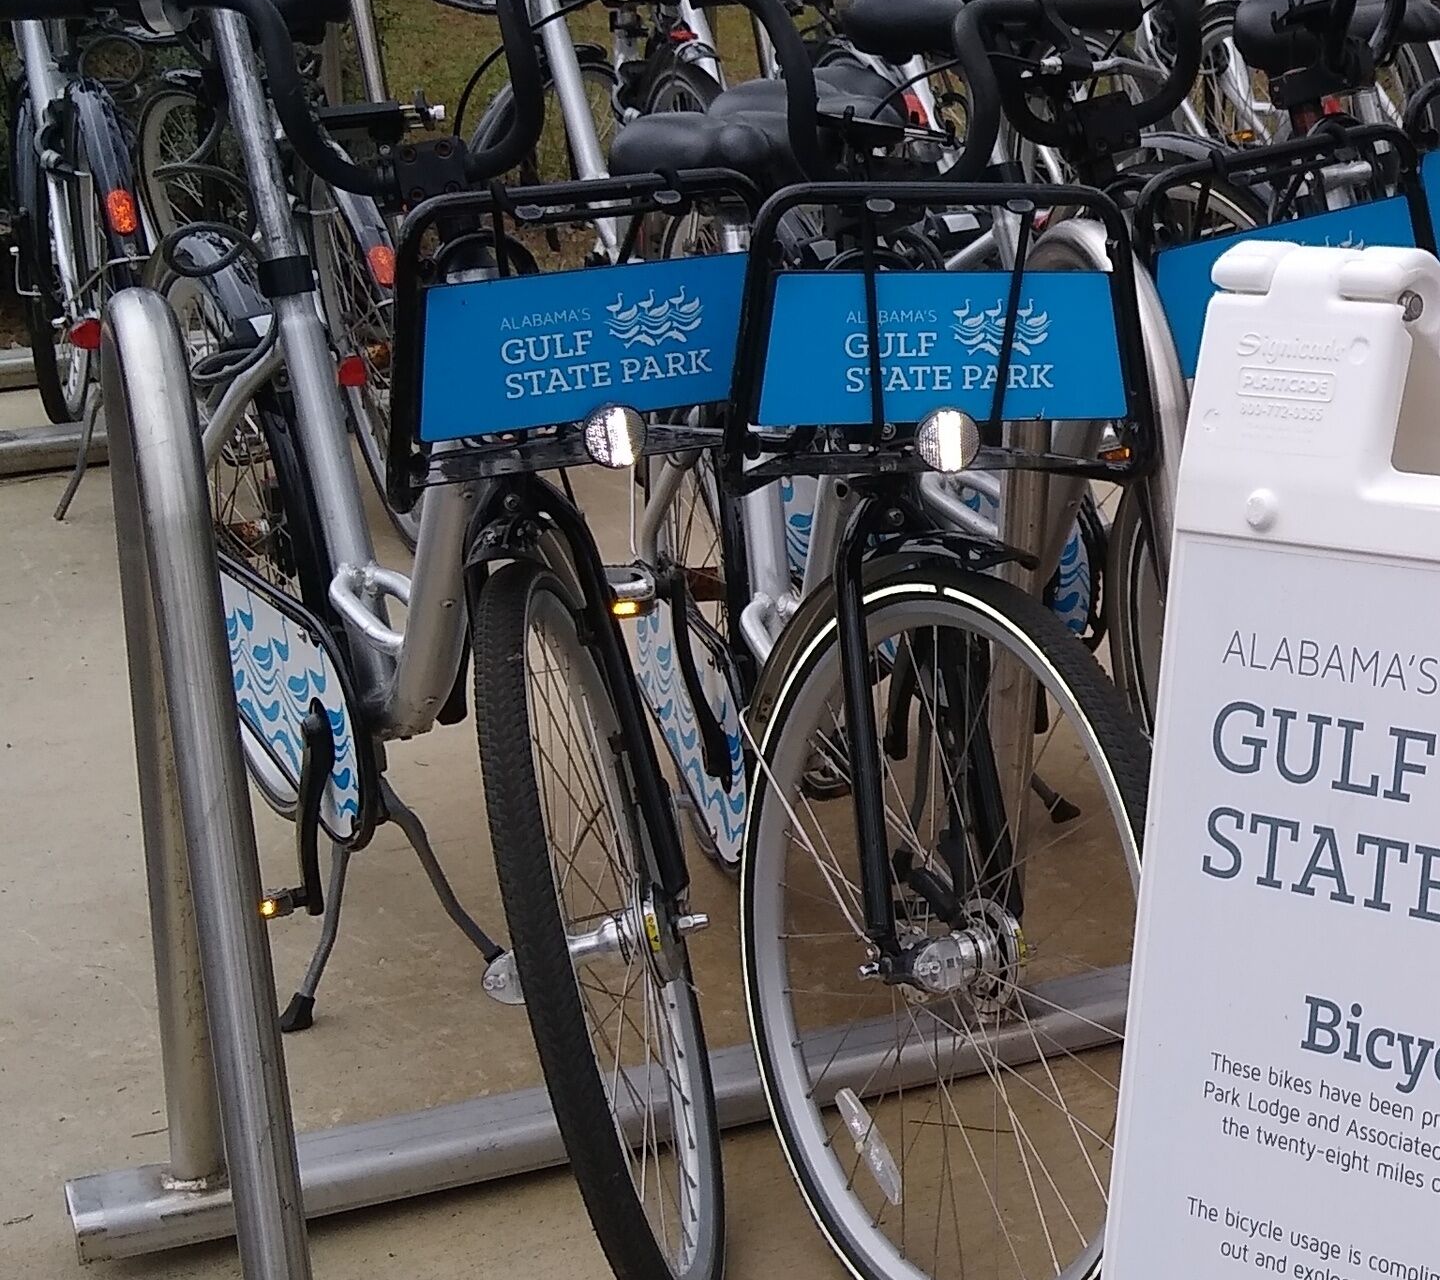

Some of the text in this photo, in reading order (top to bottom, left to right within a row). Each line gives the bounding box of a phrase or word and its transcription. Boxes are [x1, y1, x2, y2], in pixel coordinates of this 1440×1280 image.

[500, 307, 591, 331] ALABAMA'S
[846, 310, 937, 326] ALBAMA'S
[501, 330, 593, 365] GULF
[845, 332, 937, 359] GULF
[505, 348, 712, 400] STATE PARK
[962, 364, 1055, 390] PARK
[1221, 629, 1439, 695] ALABAMA'S
[1212, 700, 1438, 804] GULF
[1210, 1051, 1262, 1082] These
[1267, 1065, 1313, 1096] bikes
[1319, 1078, 1362, 1108] have
[1368, 1091, 1414, 1123] been
